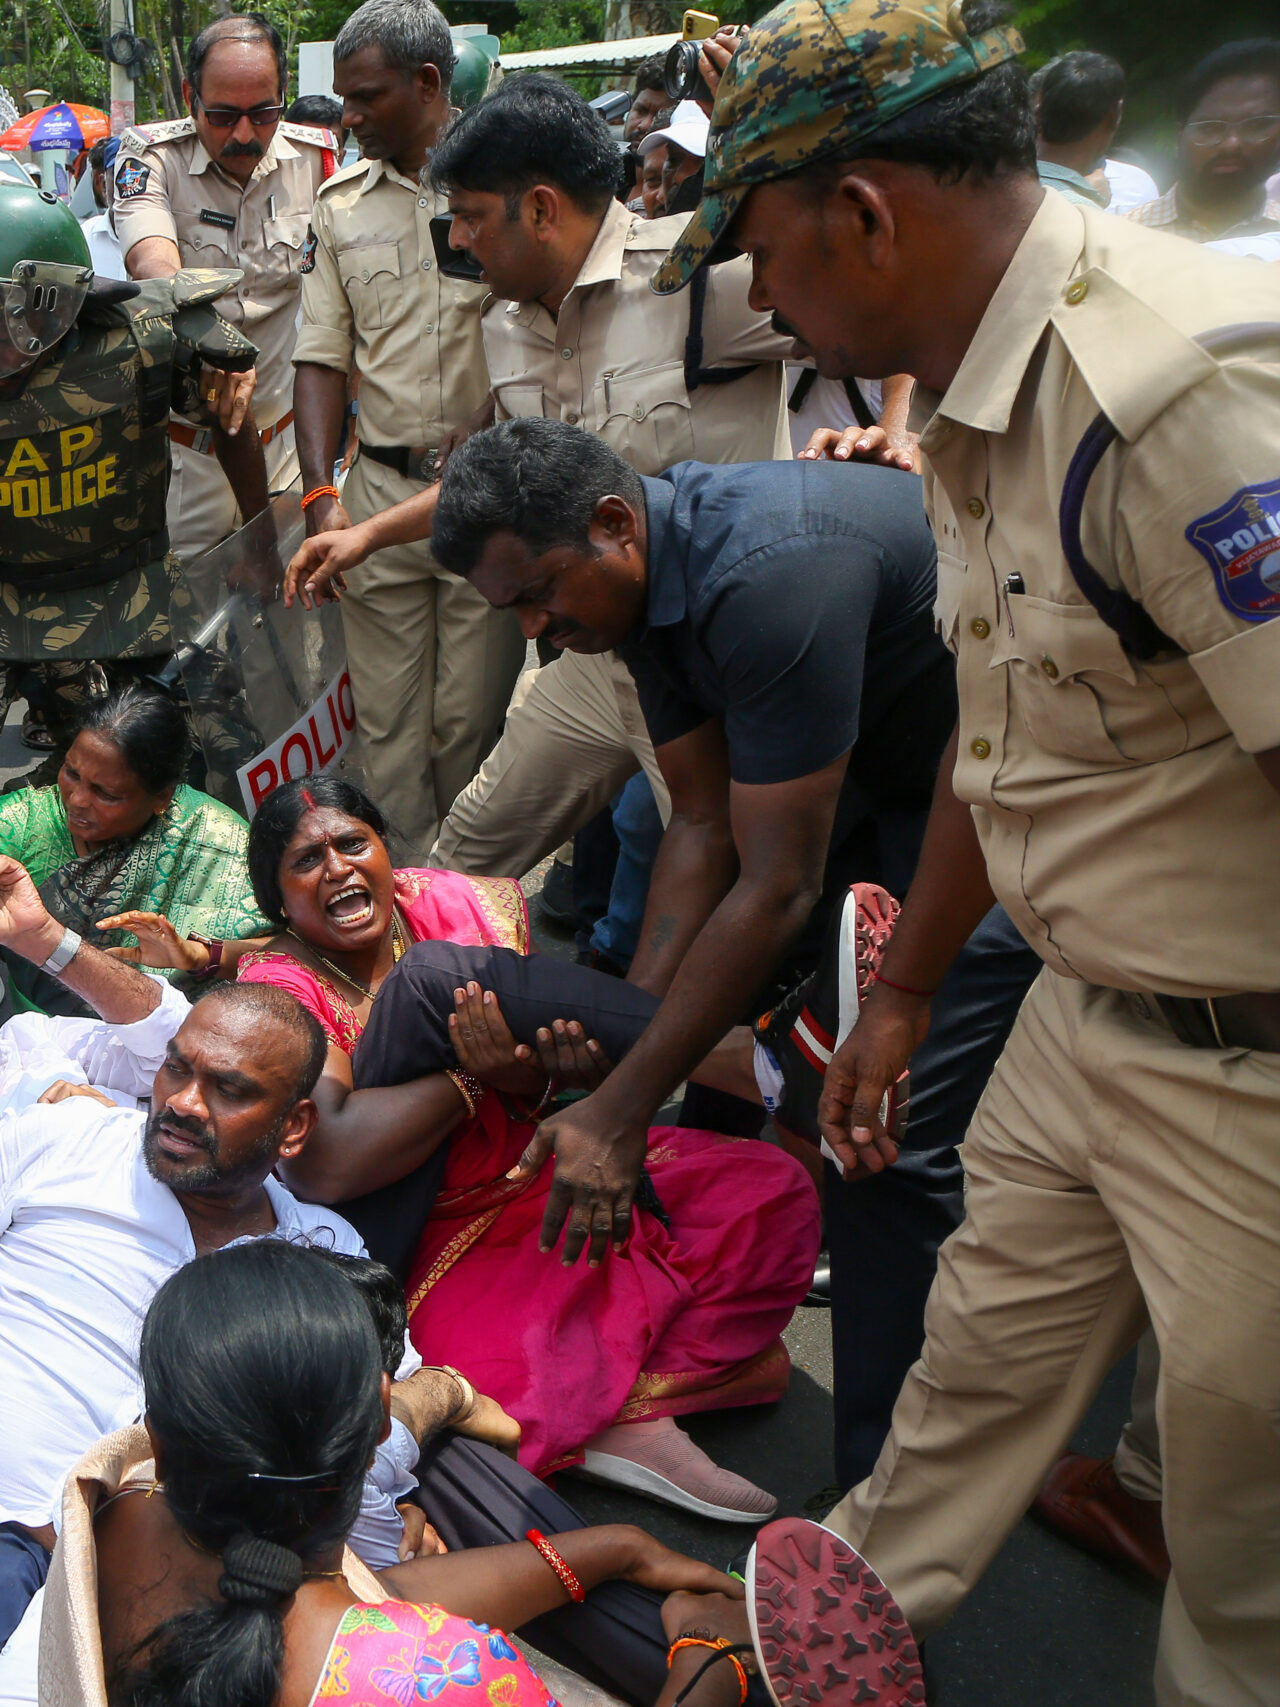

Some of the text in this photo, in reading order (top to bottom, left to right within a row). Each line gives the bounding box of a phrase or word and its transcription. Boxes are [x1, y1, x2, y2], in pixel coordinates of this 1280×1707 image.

[4, 425, 94, 476] A P
[1214, 510, 1280, 560] POLI
[1235, 540, 1280, 568] VIJAYAWA
[247, 672, 356, 809] POLIC
